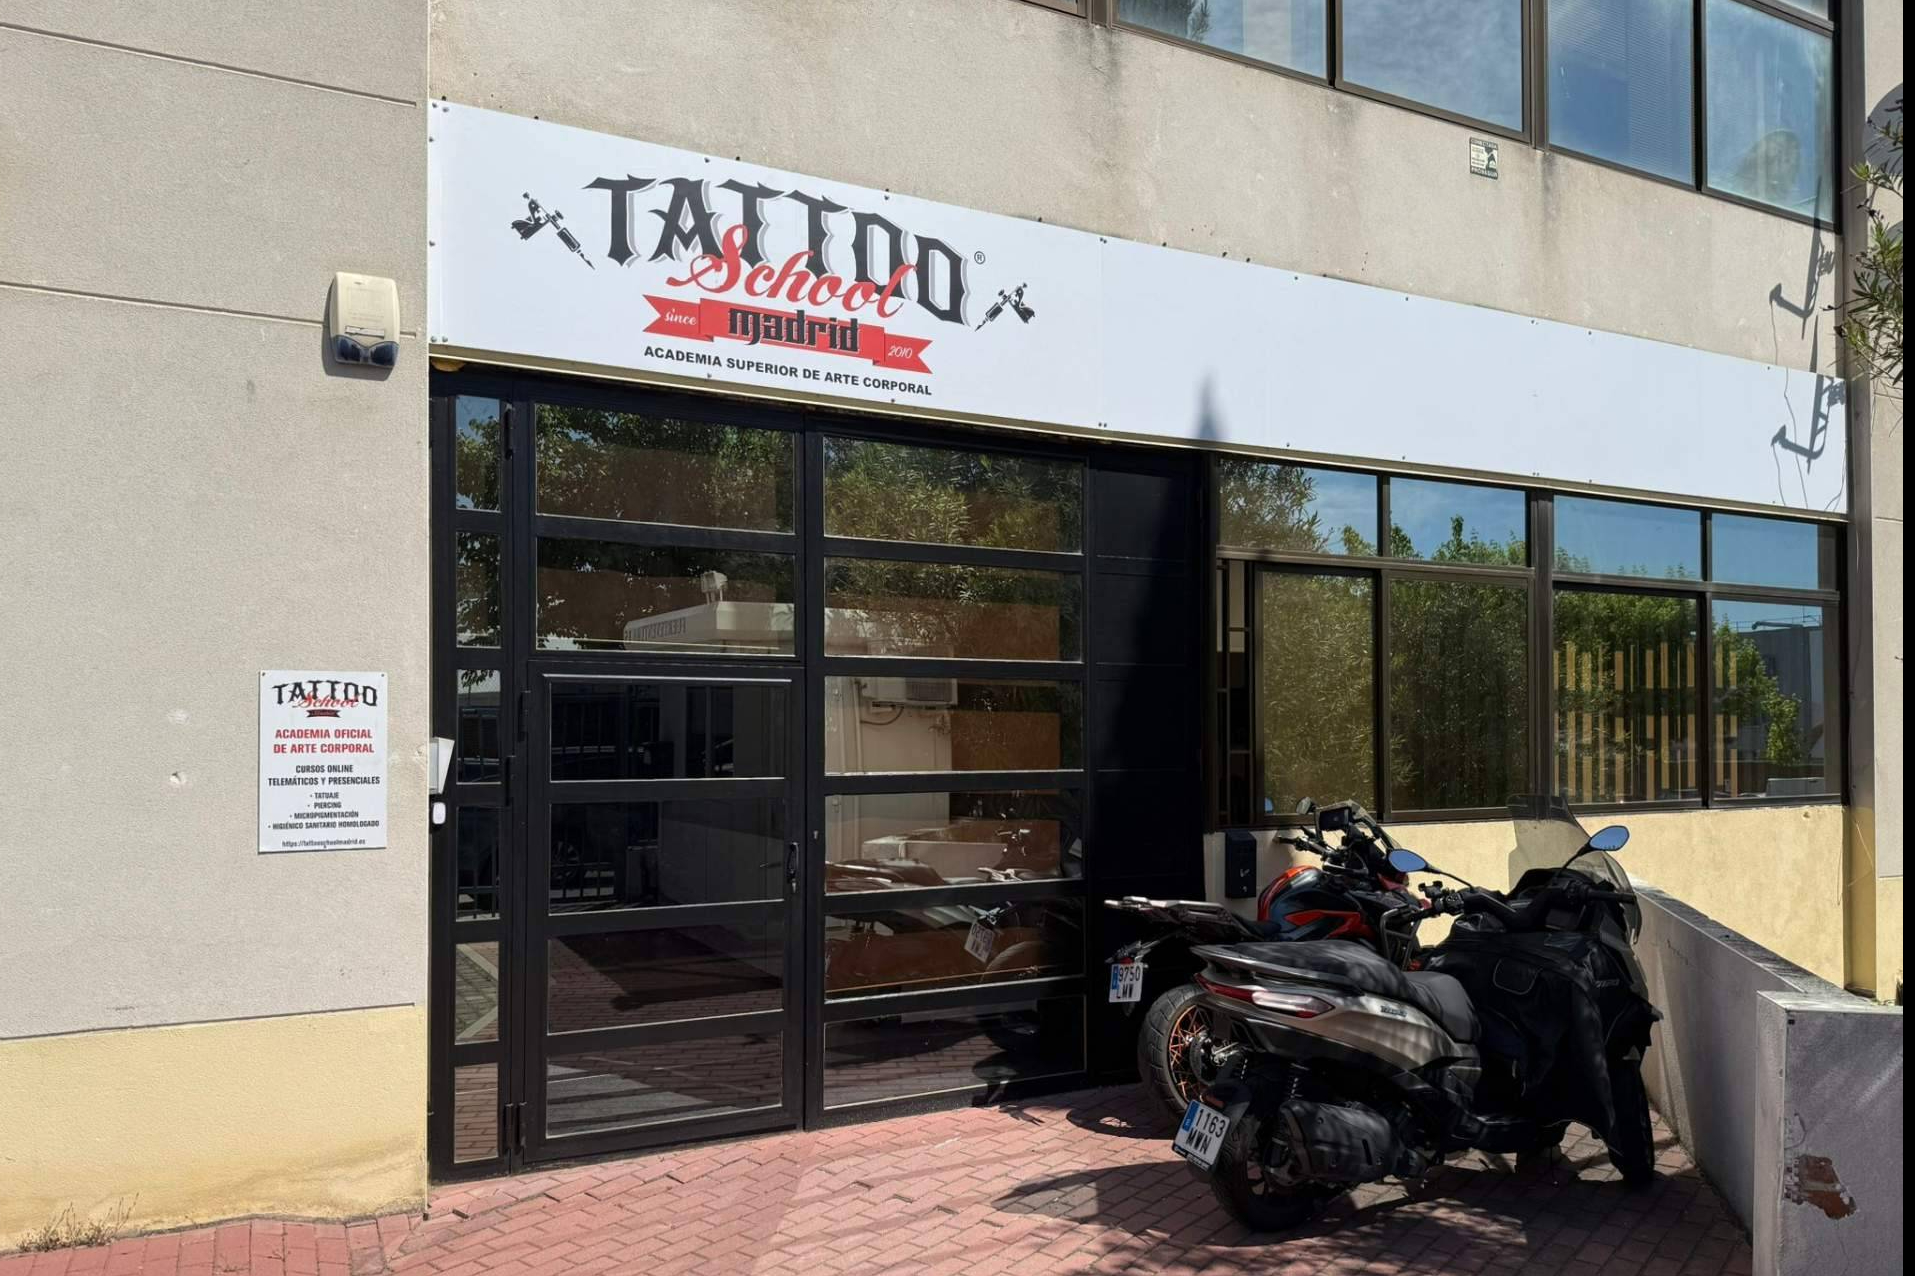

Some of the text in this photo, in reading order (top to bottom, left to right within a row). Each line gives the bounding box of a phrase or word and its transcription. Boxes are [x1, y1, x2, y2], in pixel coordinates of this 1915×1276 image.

[582, 173, 971, 327] TATTOO
[666, 223, 917, 318] School
[664, 308, 697, 326] since
[728, 307, 861, 353] madrid
[888, 345, 913, 360] 2010
[644, 345, 933, 397] ACADEMIA SUPERIOR DE ARTE CORPORAL
[272, 680, 378, 707] TATTOO
[292, 691, 360, 708] School
[275, 729, 373, 739] ACADEMIA OFICIAL
[273, 743, 375, 754] DE ARTE CORPORAL
[296, 764, 353, 773] CURSOS ONLINE
[268, 775, 380, 786] TELEMÁTICOS Y PRESENCIALES
[294, 810, 359, 819] MICROPIGMENTACIÓN
[305, 820, 337, 829] SANITARIO
[338, 820, 380, 828] HOMOLOGADO
[1119, 965, 1141, 982] 9750
[1195, 1108, 1226, 1138] 1163
[1185, 1127, 1212, 1155] MWN
